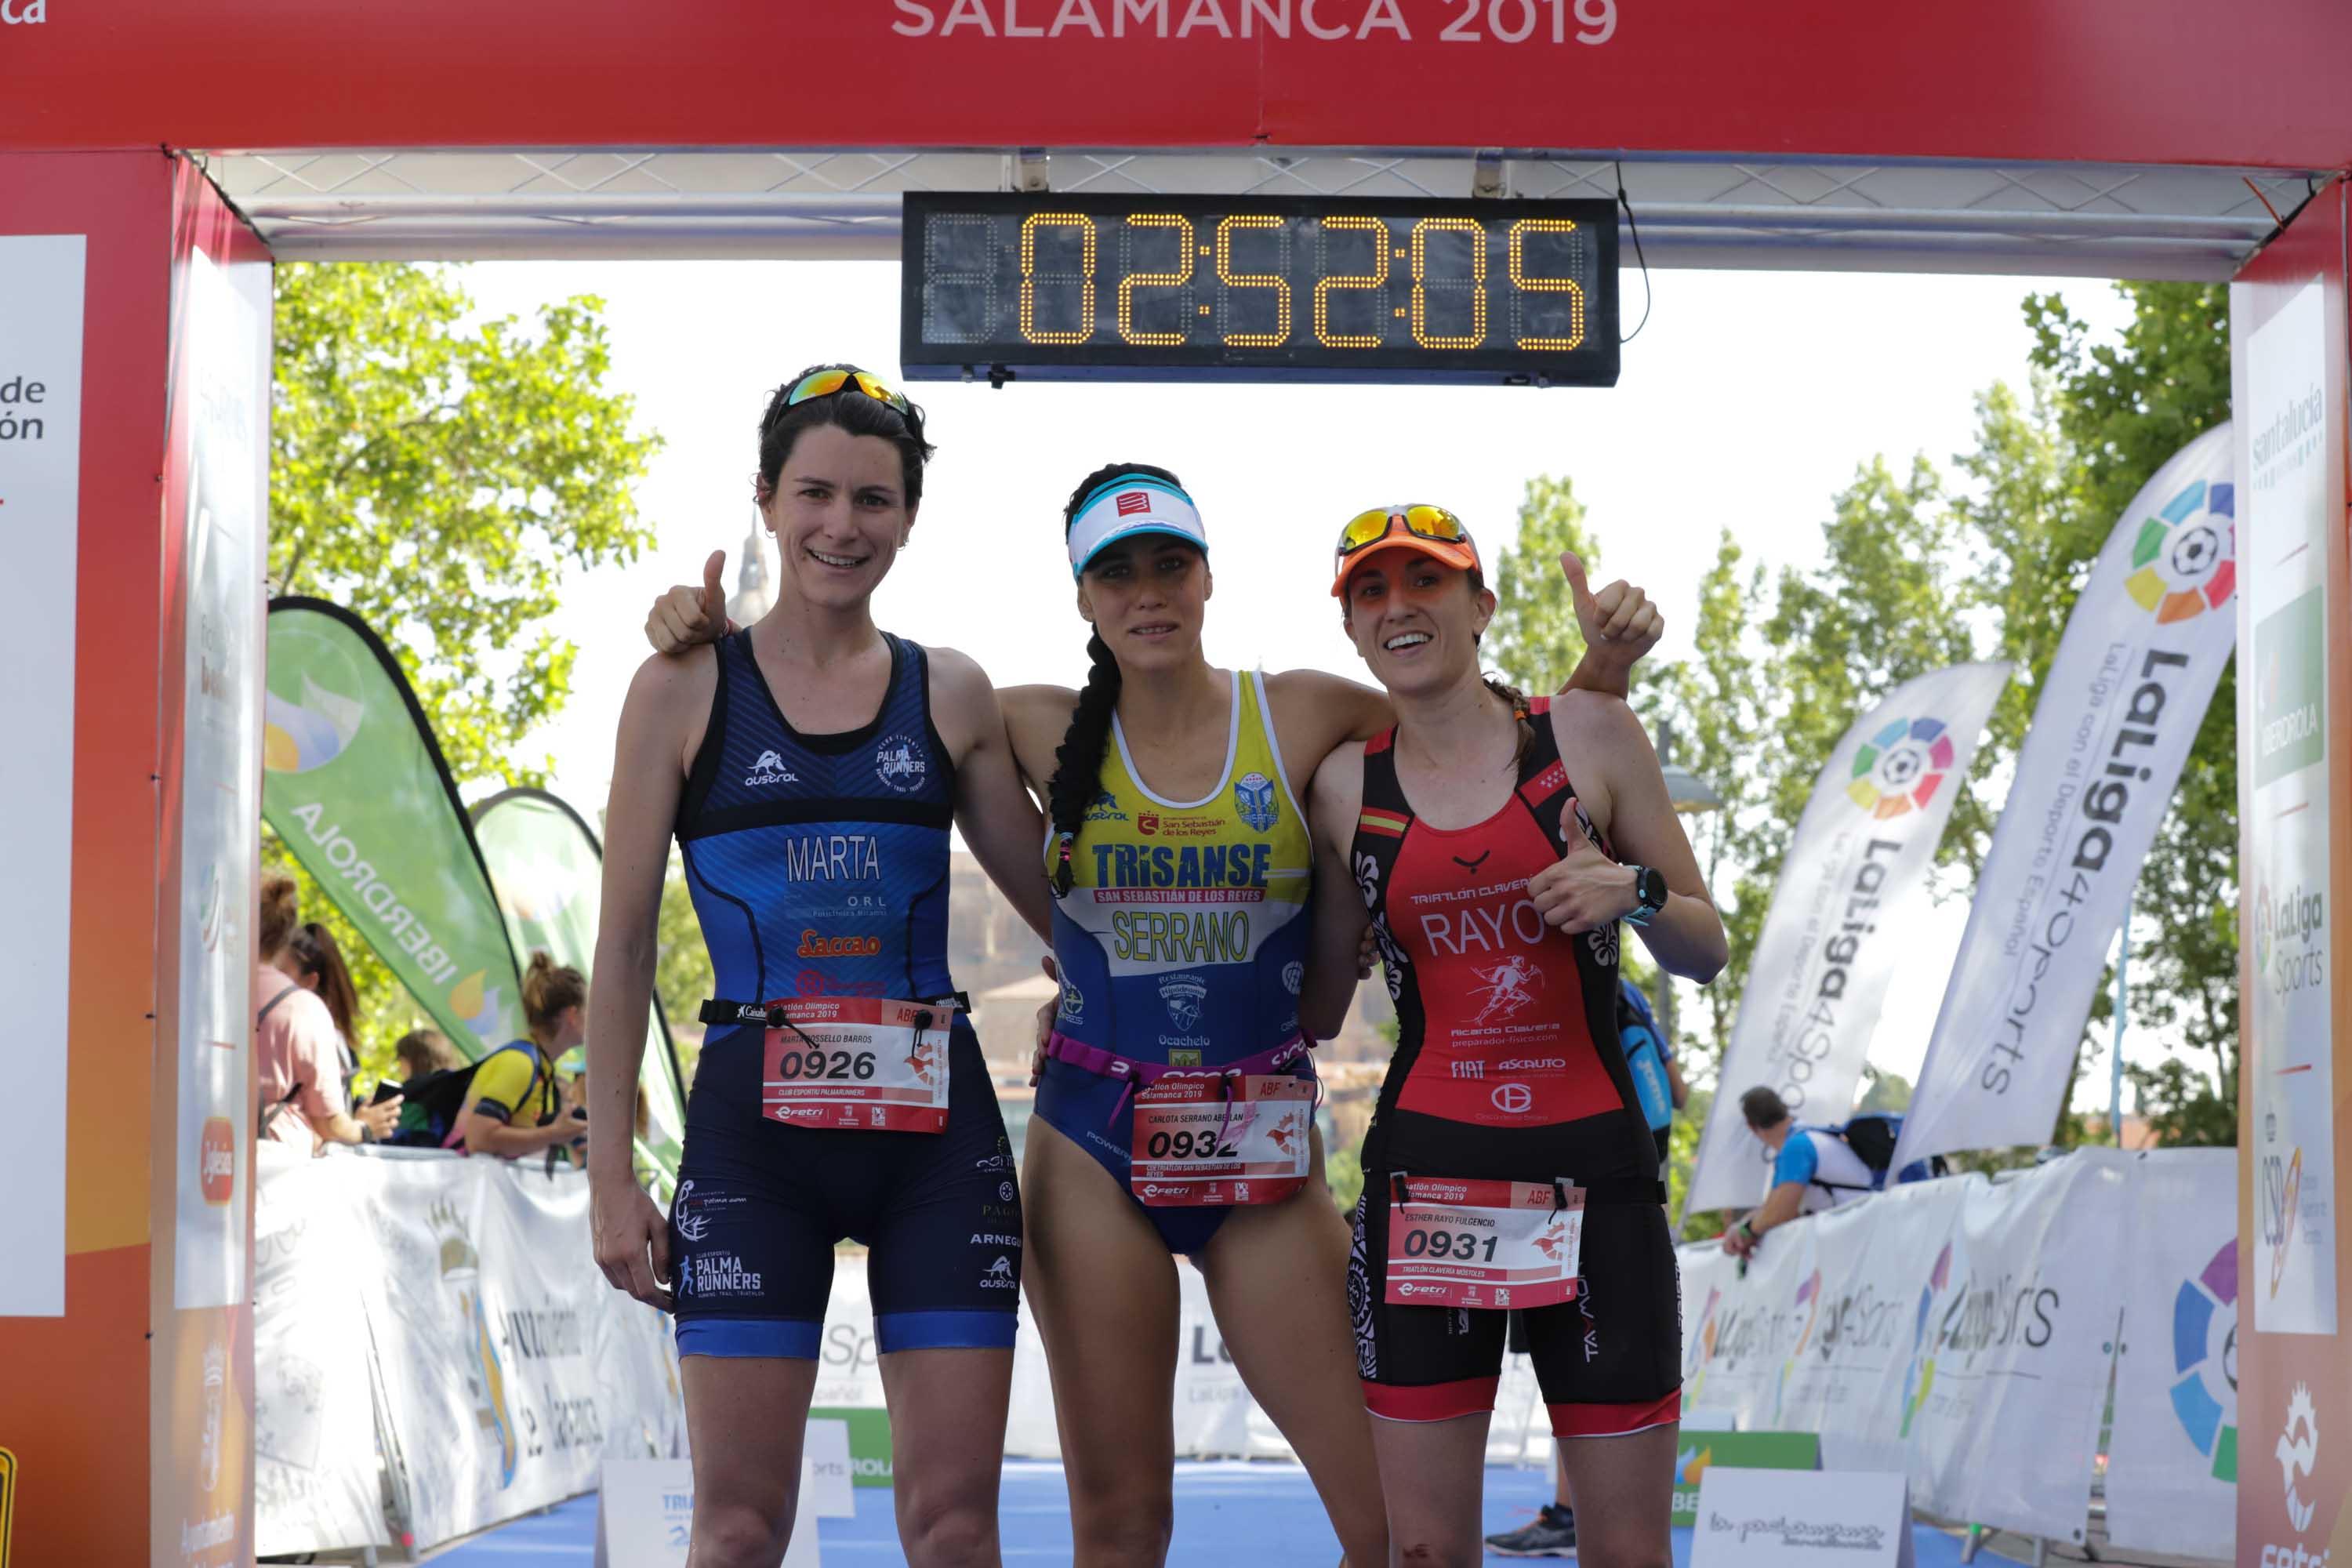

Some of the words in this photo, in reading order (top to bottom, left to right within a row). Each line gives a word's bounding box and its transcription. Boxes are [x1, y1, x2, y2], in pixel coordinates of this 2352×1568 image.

[891, 0, 1411, 41] SALAMANCA
[1440, 0, 1617, 45] 2019
[1020, 212, 1584, 350] 02:52:05
[877, 749, 910, 764] PALMA
[883, 760, 925, 775] RUNNERS
[745, 773, 799, 786] austral
[786, 835, 881, 884] MARTA
[1098, 891, 1120, 902] SAN
[1123, 889, 1185, 902] SEBASTIÁN
[1188, 891, 1201, 902] DE
[1205, 891, 1225, 902] LOS
[1228, 890, 1261, 902] REYES
[2275, 884, 2323, 942] LaLiga
[1112, 910, 1249, 963] SERRANO
[1420, 899, 1545, 956] RAYO
[2275, 947, 2323, 1004] Sports
[817, 1010, 837, 1018] 2019
[844, 1034, 872, 1044] BARROS
[779, 1051, 877, 1080] 0926
[1451, 1060, 1486, 1079] FIAT
[1149, 1113, 1178, 1123] CARLOTA
[1180, 1113, 1212, 1123] SERRANO
[1214, 1113, 1243, 1122] ABELAN
[1443, 1192, 1465, 1200] 2019
[1527, 1190, 1551, 1205] ABF
[1405, 1213, 1432, 1221] ESTHER
[1434, 1214, 1454, 1224] RAYO
[1455, 1216, 1496, 1227] FULGENCIO
[1403, 1229, 1498, 1262] 0931
[696, 1256, 743, 1276] PALMA
[697, 1272, 761, 1293] RUNNERS
